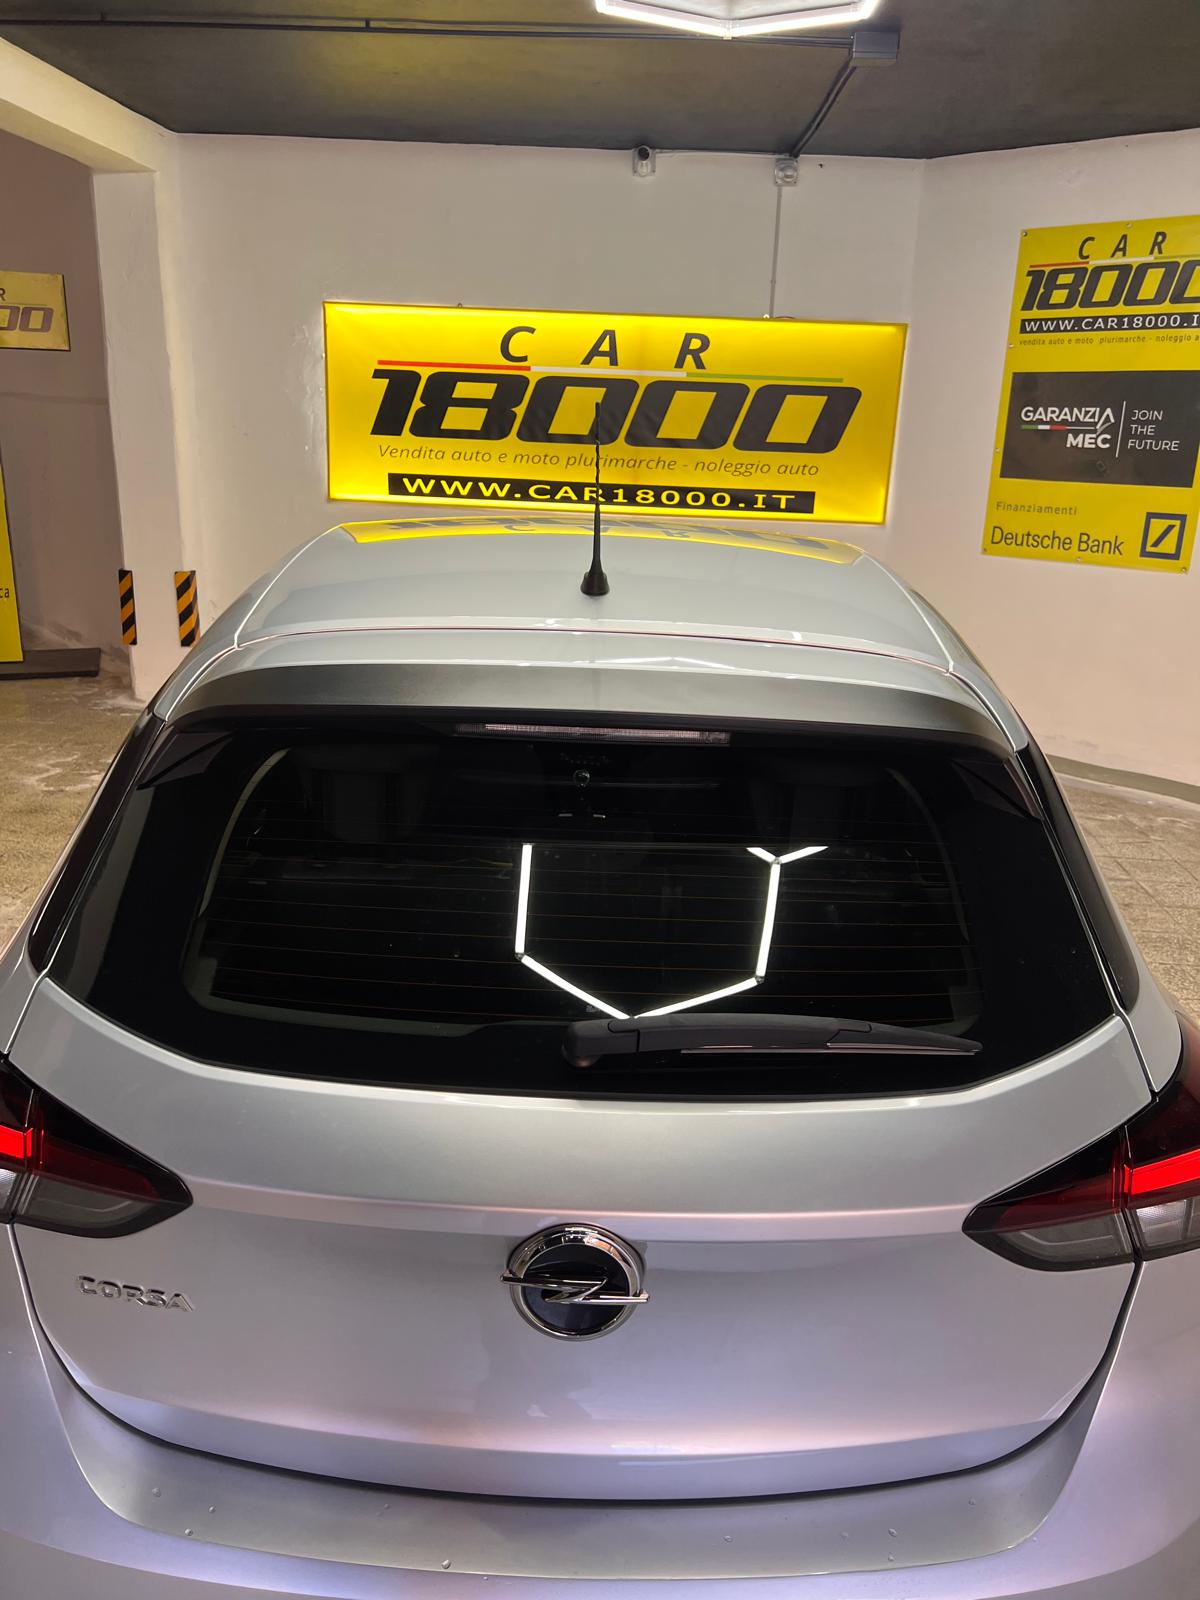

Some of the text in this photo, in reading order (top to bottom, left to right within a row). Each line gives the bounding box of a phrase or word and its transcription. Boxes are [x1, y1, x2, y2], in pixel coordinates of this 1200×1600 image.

[1078, 231, 1167, 260] CAR
[500, 326, 711, 370] CAR
[1048, 337, 1066, 345] auto
[1074, 337, 1094, 345] moto
[1099, 335, 1146, 345] plurimarche
[1155, 333, 1192, 344] noleggio
[370, 369, 862, 454] 18000
[1021, 406, 1115, 427] GARANZIA
[1131, 409, 1163, 421] JOIN
[1066, 433, 1112, 449] MEC
[1130, 424, 1156, 436] THE
[1128, 439, 1180, 451] FUTURE
[379, 444, 446, 461] Vendita
[451, 448, 491, 463] auto
[498, 452, 508, 463] e
[513, 451, 560, 466] moto
[565, 452, 677, 471] pluimarche
[694, 458, 771, 477] noleggio
[777, 461, 819, 476] auto
[402, 478, 796, 510] WWW.CAR18000.IT
[996, 501, 1078, 516] Finanziamenti
[991, 525, 1125, 556] Deutsche Bank
[79, 1275, 194, 1312] CORSA
